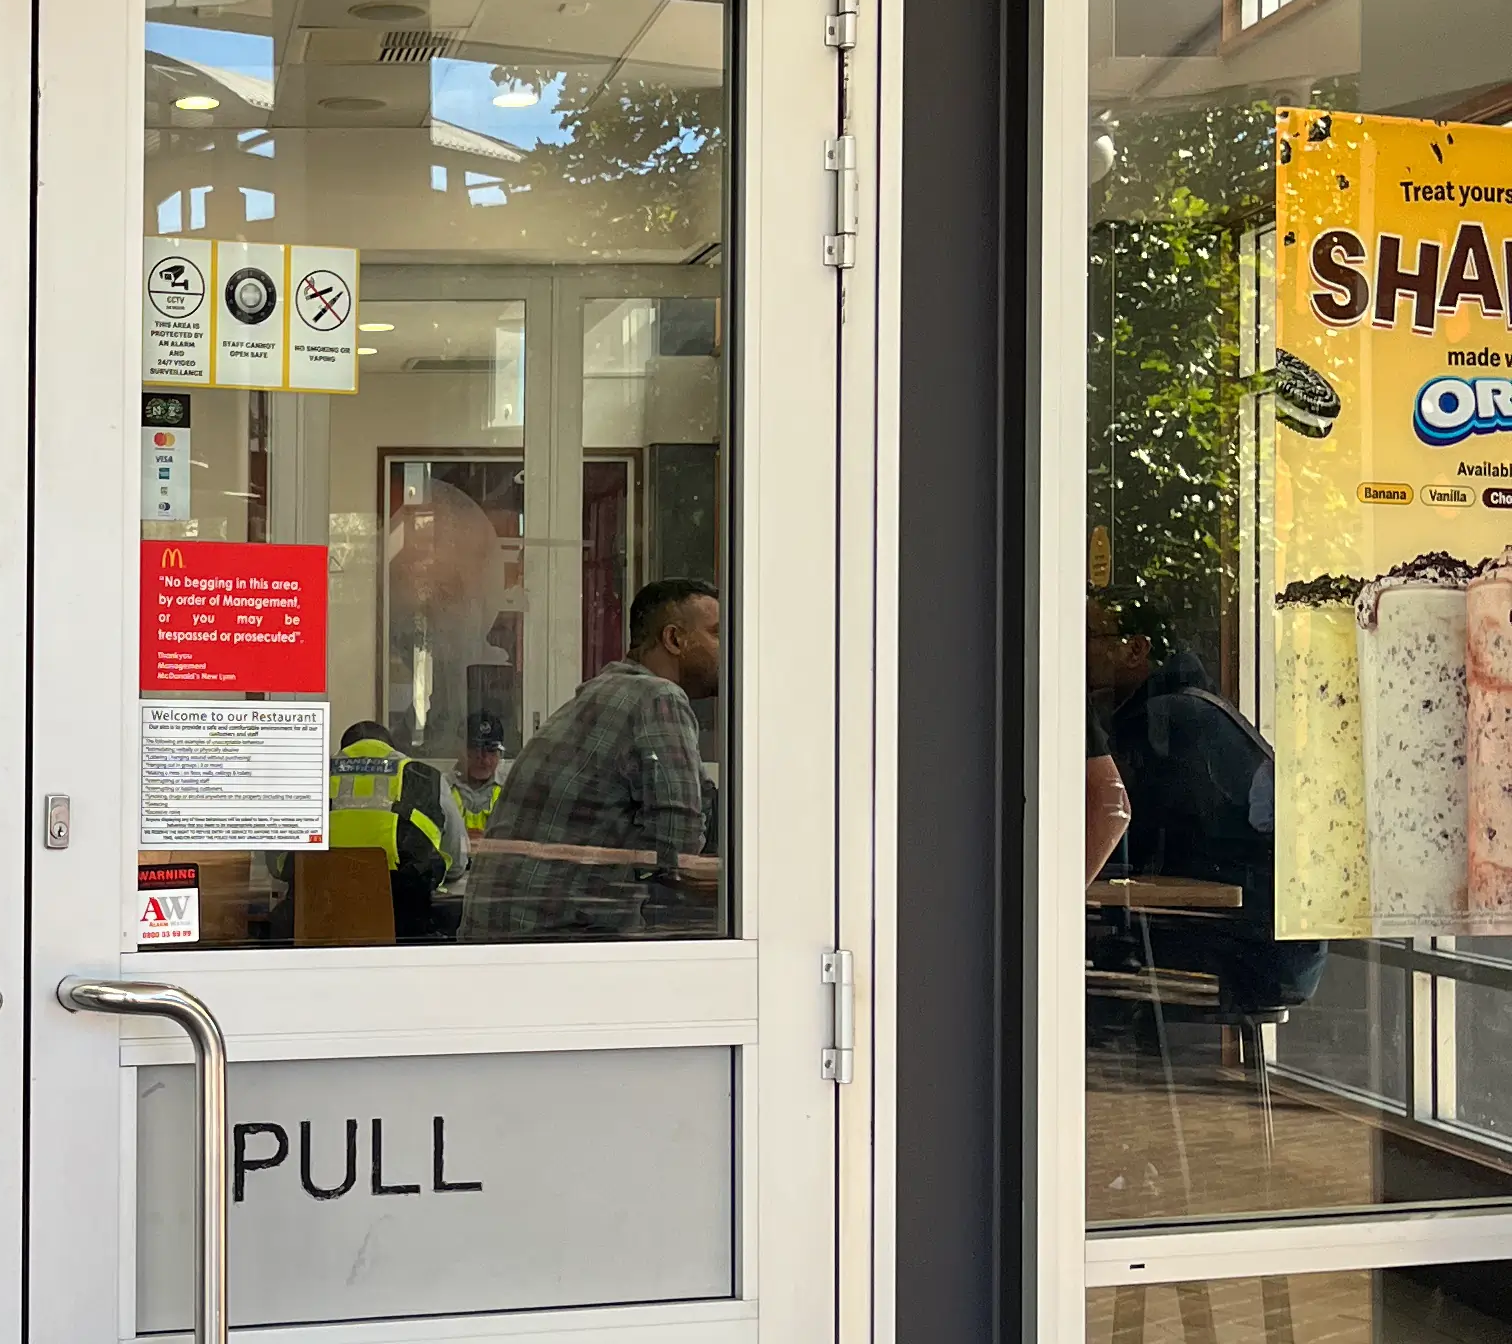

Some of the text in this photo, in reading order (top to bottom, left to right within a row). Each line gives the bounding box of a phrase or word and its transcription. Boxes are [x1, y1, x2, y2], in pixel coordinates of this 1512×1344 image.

[1400, 181, 1455, 202] Treat
[1310, 222, 1512, 336] SHA
[167, 296, 185, 304] CCTV
[173, 321, 191, 329] AREA
[151, 330, 192, 338] PROTECTED
[1448, 347, 1501, 367] made
[150, 368, 203, 376] SURVEILLANCE
[1364, 487, 1407, 500] Banana
[1429, 489, 1467, 502] Vanilla
[185, 576, 232, 592] begging
[236, 577, 246, 589] in
[250, 577, 268, 590] this
[159, 593, 173, 608] by
[176, 594, 206, 606] order
[209, 594, 220, 607] of
[159, 613, 300, 627] or you may be
[158, 629, 217, 643] trespassed
[220, 632, 231, 642] or
[151, 710, 317, 723] Welcome to our Restaurant
[139, 869, 195, 880] WARNING
[233, 1116, 483, 1202] PULL
